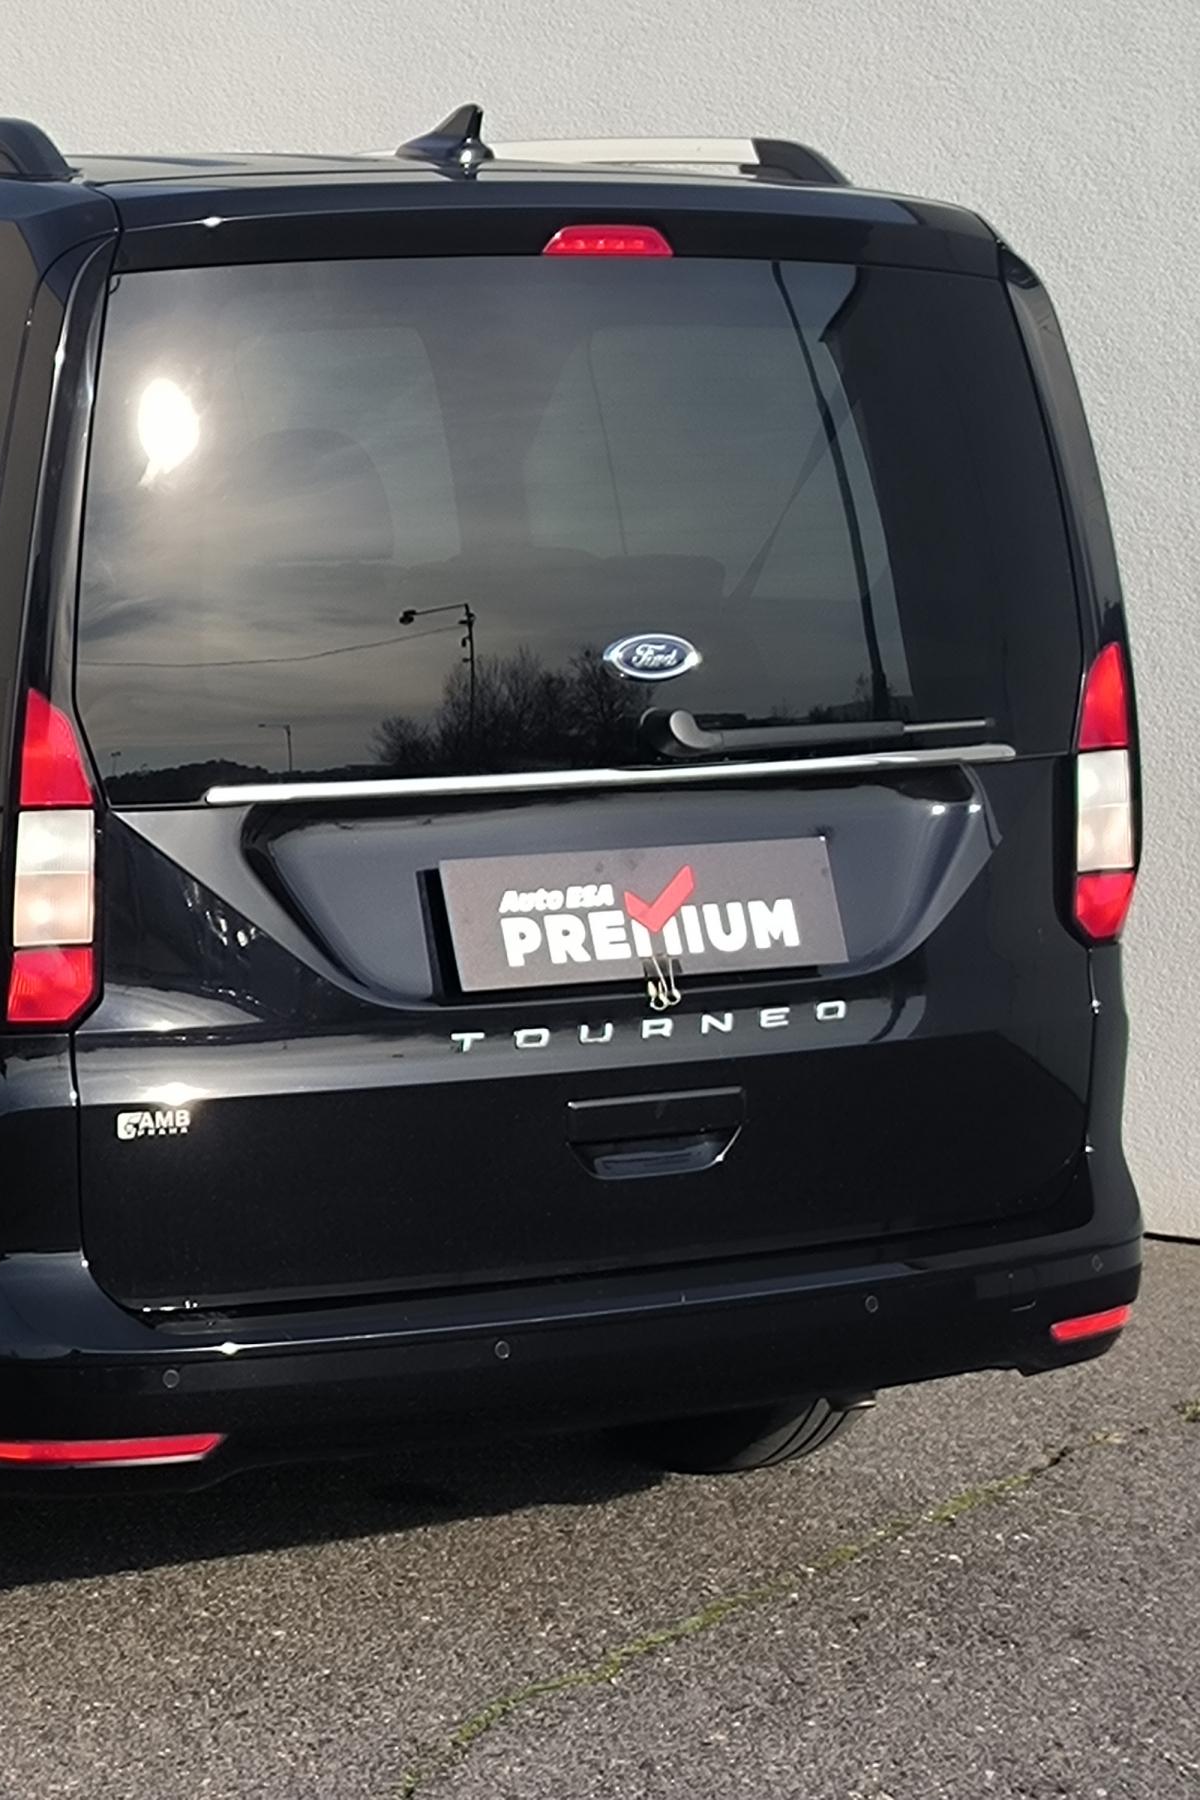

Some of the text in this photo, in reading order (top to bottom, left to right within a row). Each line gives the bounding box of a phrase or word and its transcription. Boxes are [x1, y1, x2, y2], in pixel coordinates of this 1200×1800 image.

[631, 643, 678, 668] Ford
[498, 888, 564, 913] Auto
[500, 898, 800, 967] PREMIUM
[450, 999, 847, 1052] TOURNEO
